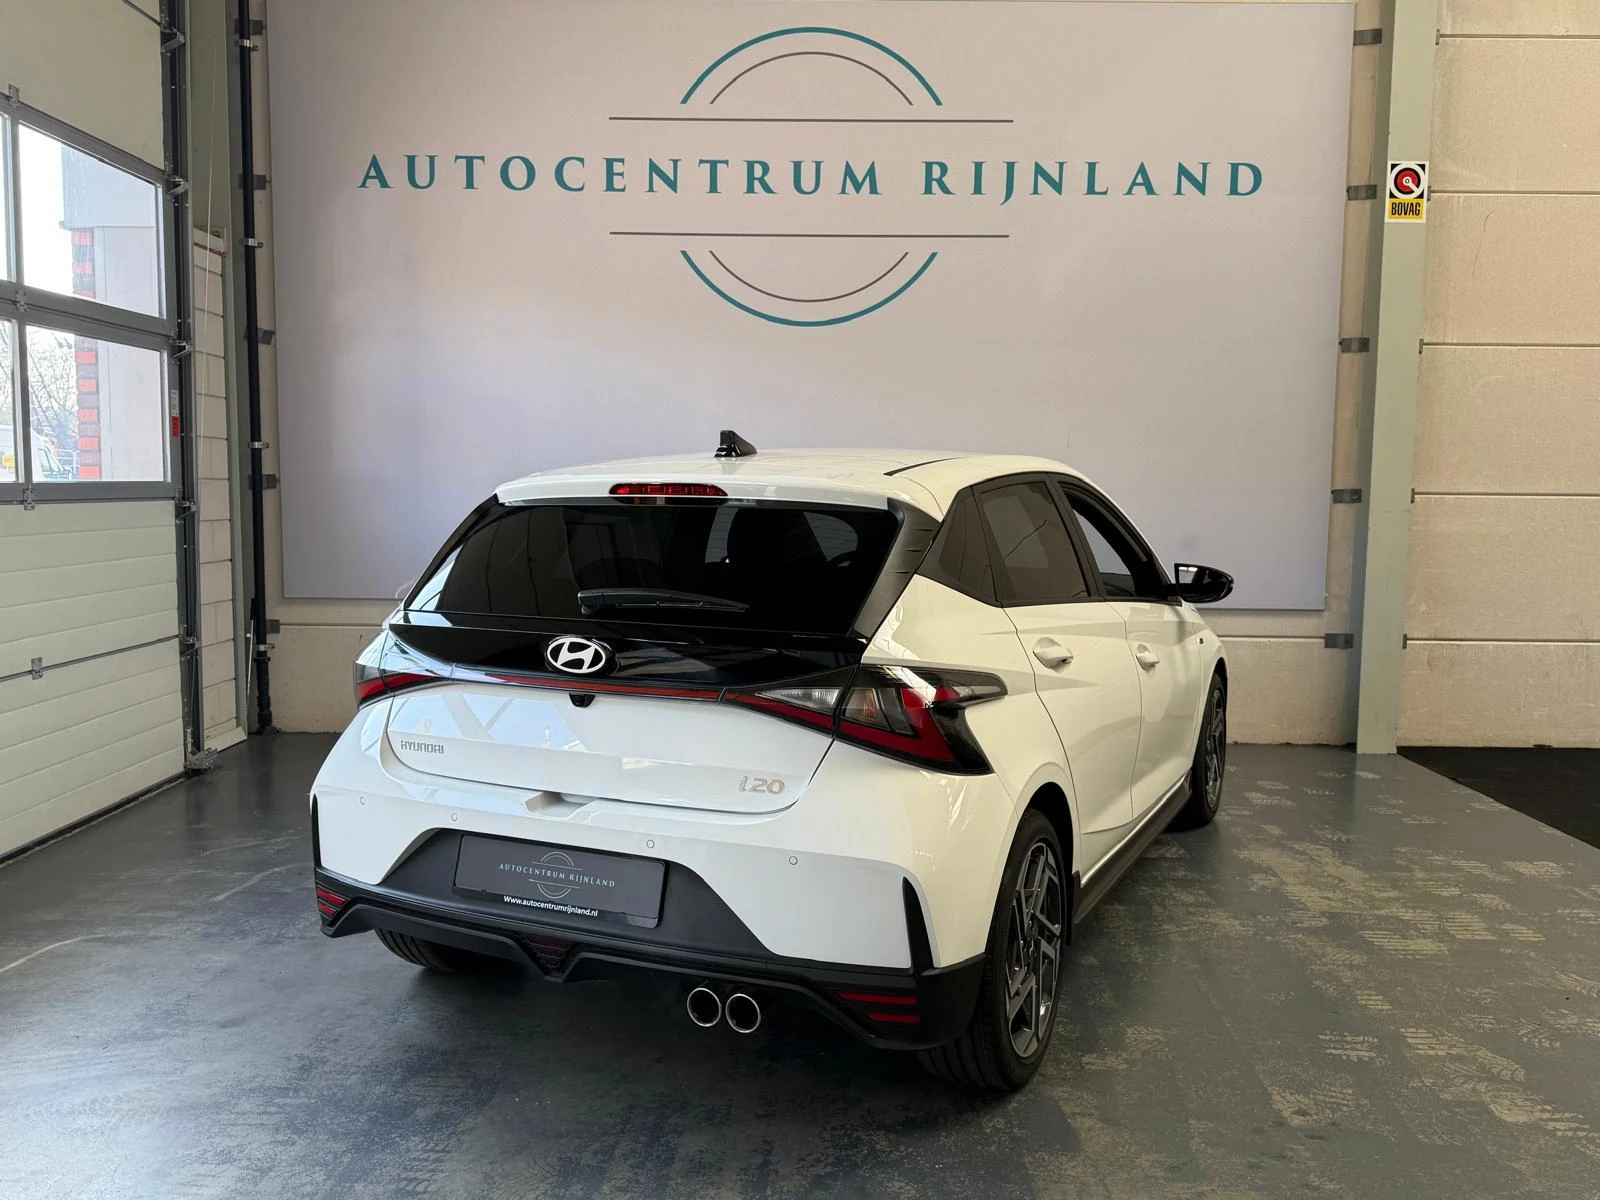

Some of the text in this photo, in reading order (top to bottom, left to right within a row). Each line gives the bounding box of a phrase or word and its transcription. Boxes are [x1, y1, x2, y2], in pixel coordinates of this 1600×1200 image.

[356, 154, 1264, 206] AUTOCENTRUM RIJNLAND
[1391, 202, 1421, 216] BOVAG
[400, 740, 445, 754] HYUNDAI
[499, 863, 616, 888] AUTOCENTRUM RIJNLAND
